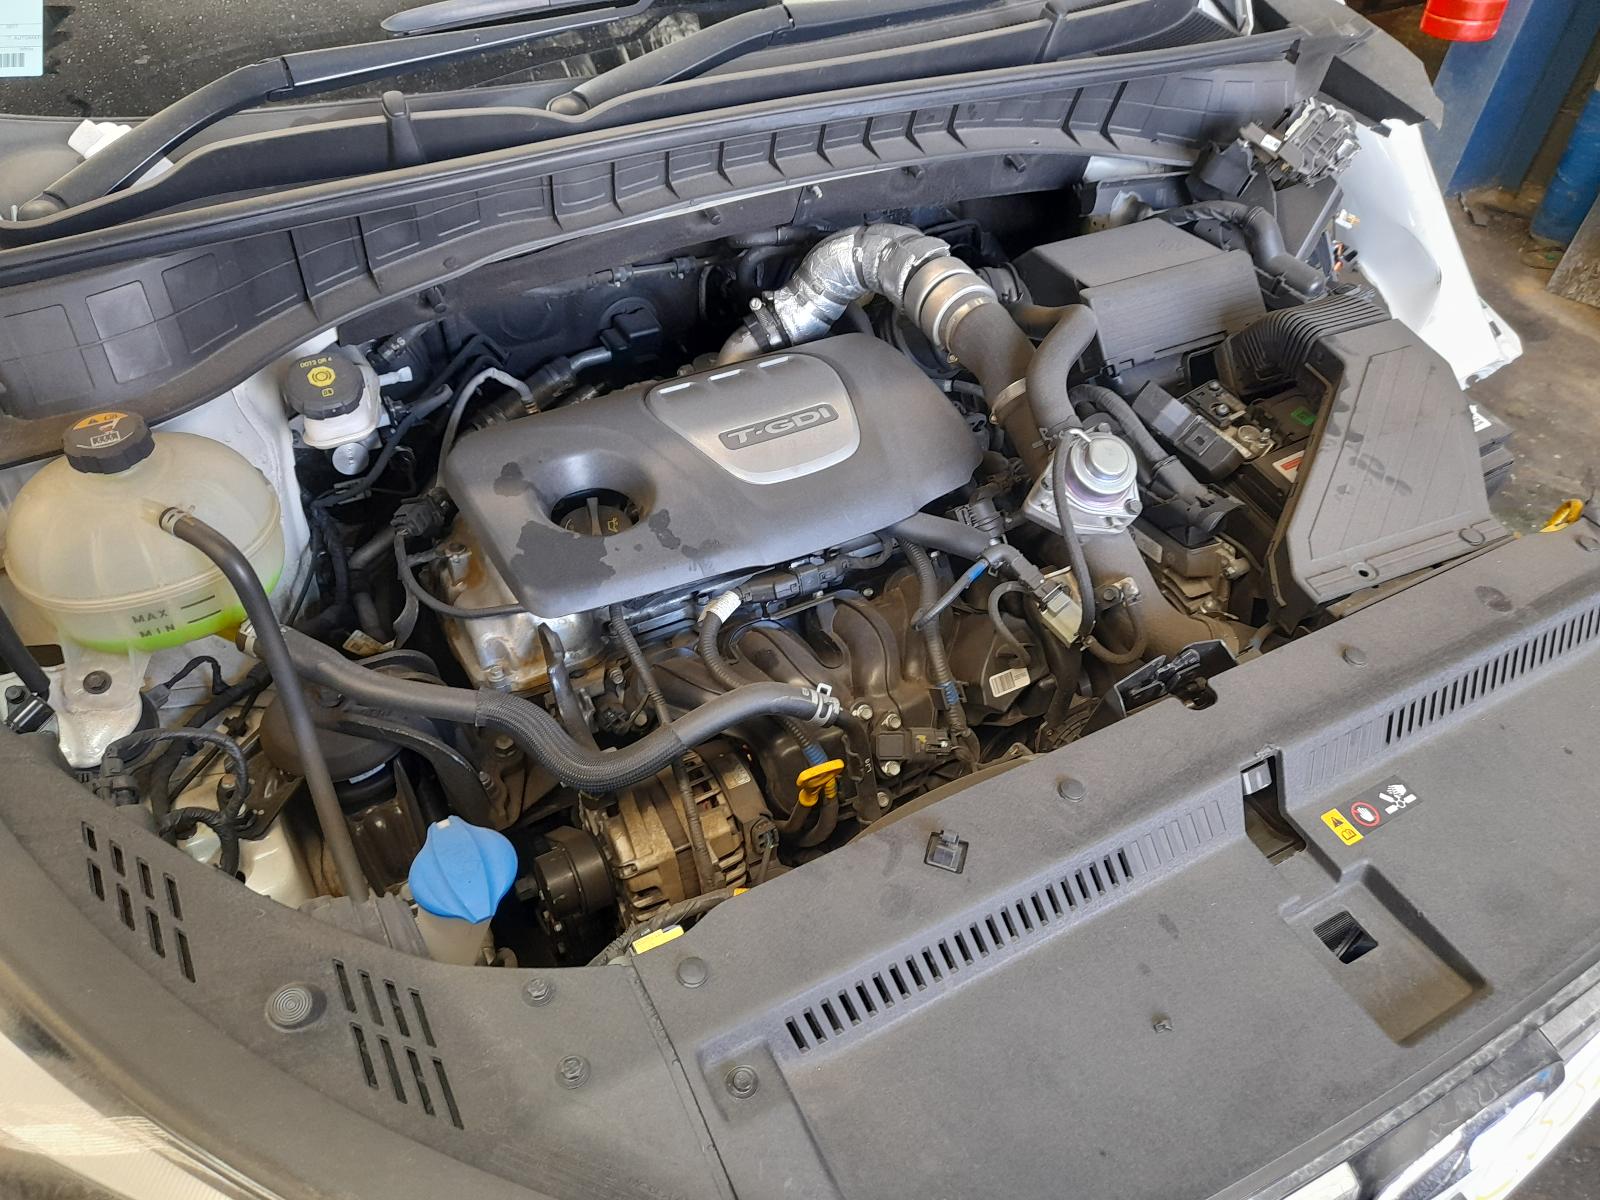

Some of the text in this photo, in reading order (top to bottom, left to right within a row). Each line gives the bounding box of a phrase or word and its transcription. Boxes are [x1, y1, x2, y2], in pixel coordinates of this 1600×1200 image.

[727, 407, 831, 443] T-GDI
[131, 609, 168, 624] MAX
[139, 624, 176, 638] MIN
